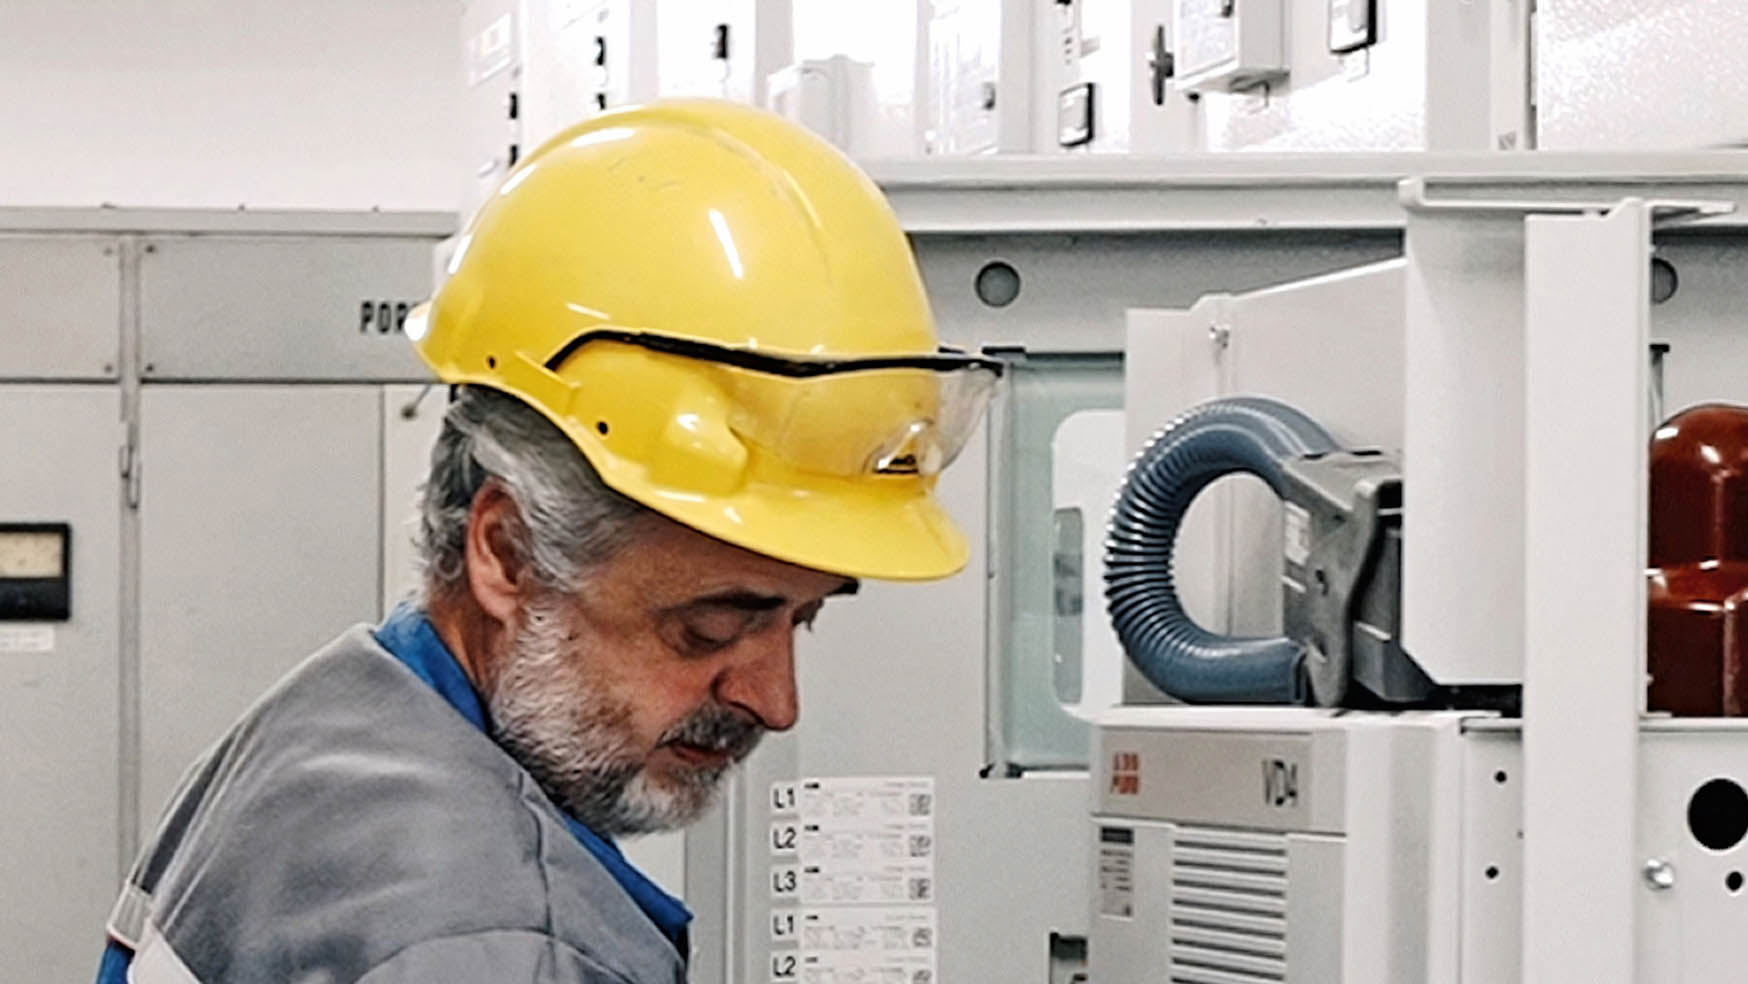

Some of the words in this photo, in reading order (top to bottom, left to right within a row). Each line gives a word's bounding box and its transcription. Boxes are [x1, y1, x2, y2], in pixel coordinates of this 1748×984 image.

[773, 786, 795, 808] L1
[773, 825, 797, 849] L2
[773, 869, 797, 892] L3
[773, 914, 794, 935] L1
[773, 955, 796, 977] L2
